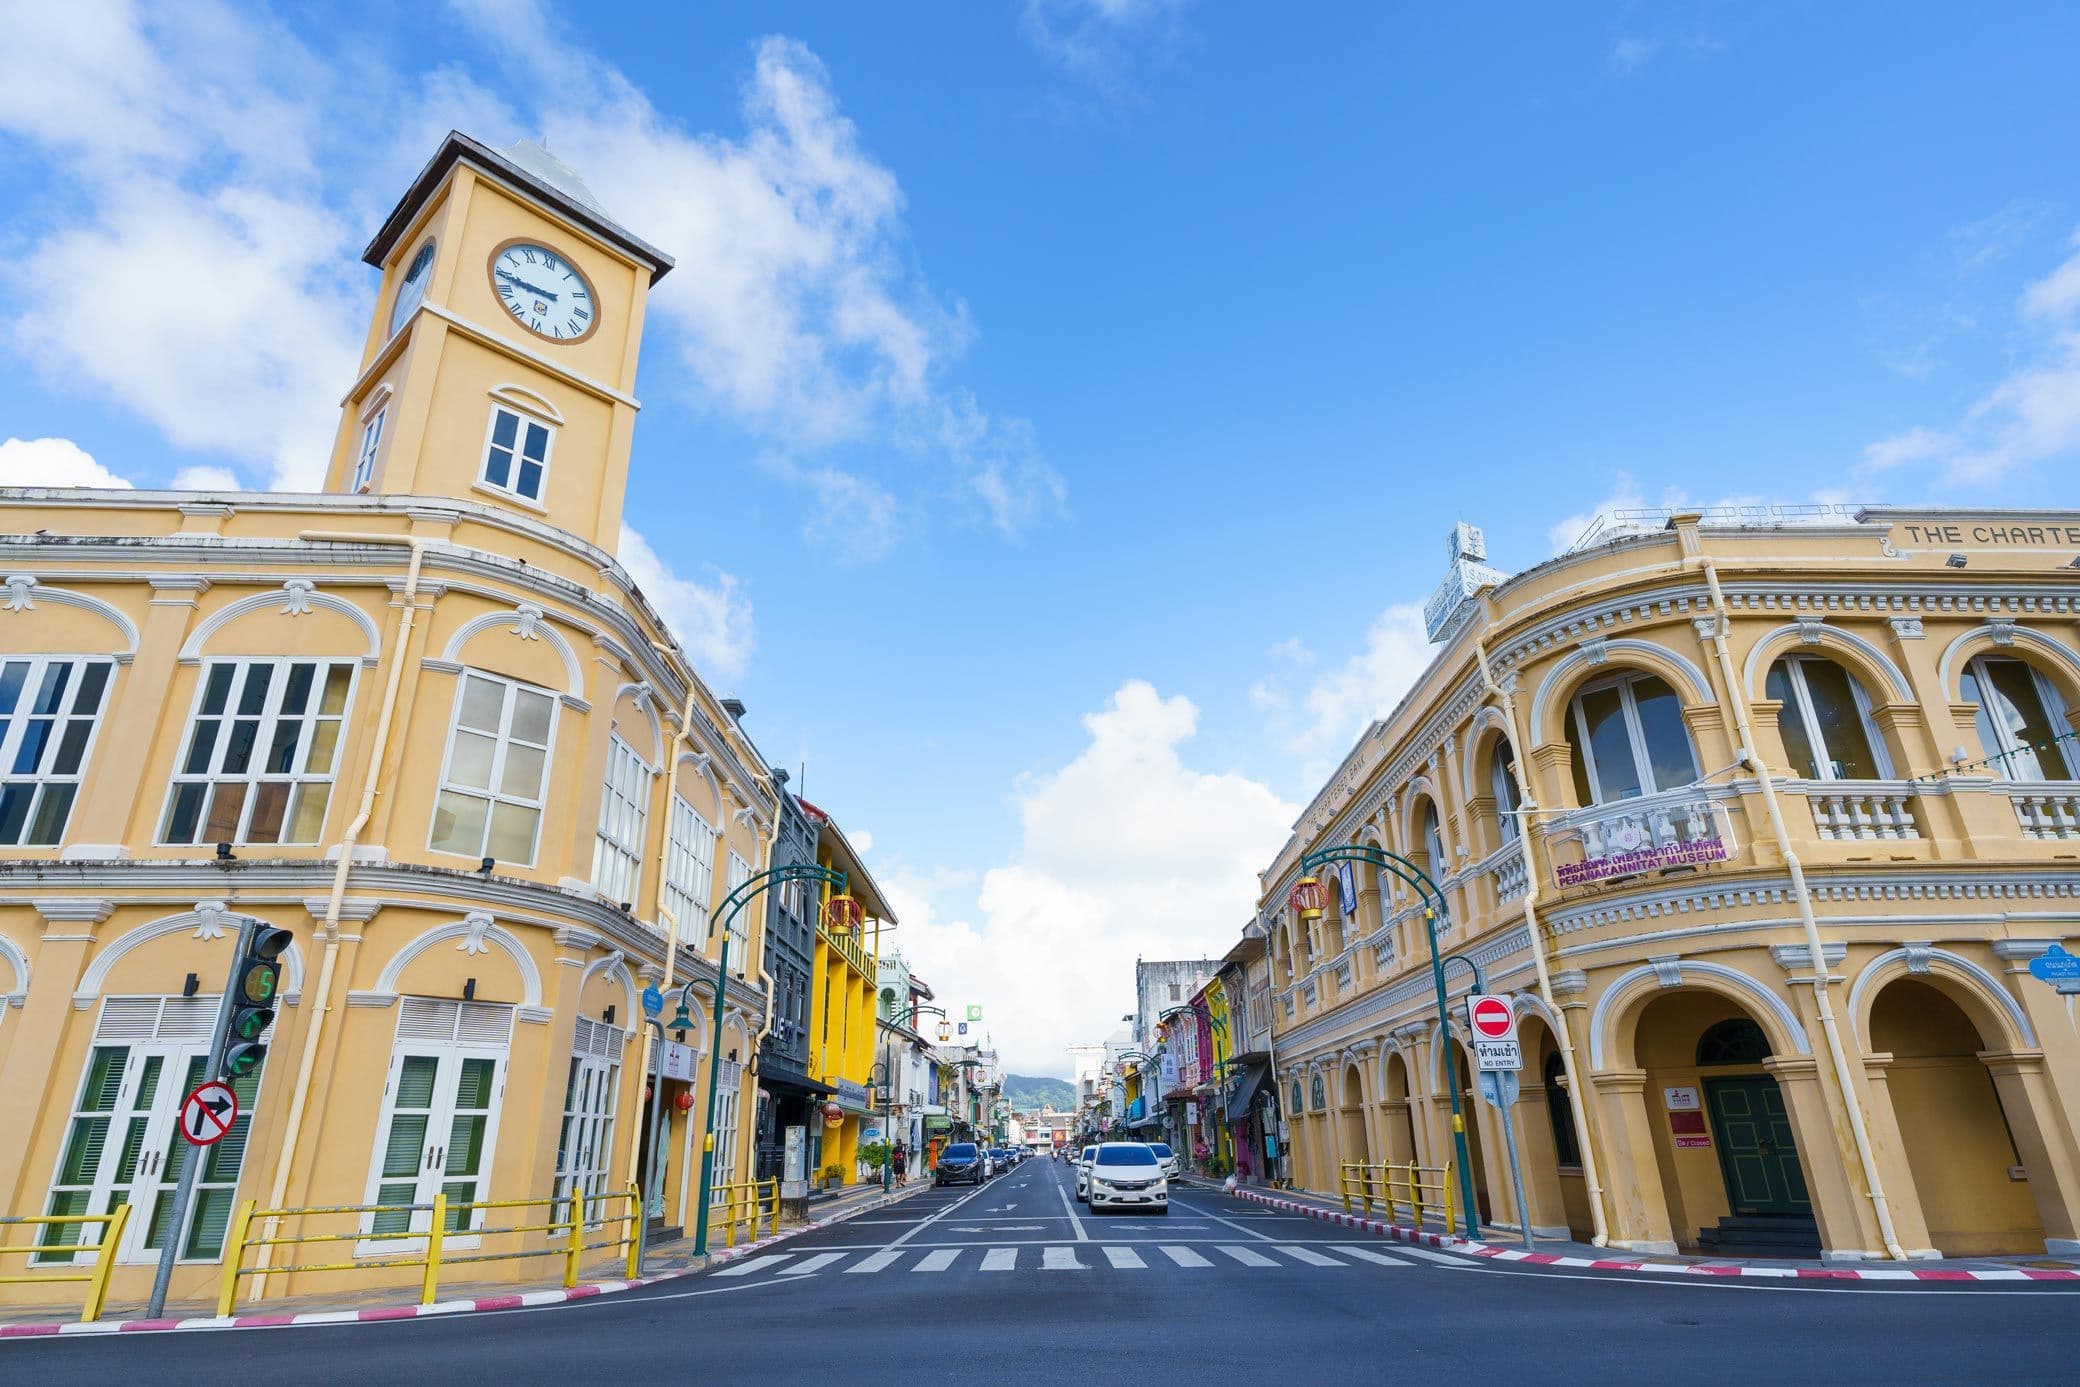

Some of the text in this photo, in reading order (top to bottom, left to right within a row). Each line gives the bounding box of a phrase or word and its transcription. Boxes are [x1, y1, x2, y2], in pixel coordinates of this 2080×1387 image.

[504, 252, 520, 268] X
[522, 250, 536, 263] XI
[542, 254, 557, 271] XII
[510, 303, 525, 319] VII
[573, 306, 589, 320] III
[531, 317, 541, 333] VI
[554, 325, 564, 339] V
[567, 319, 582, 335] IV
[1904, 526, 2080, 545] THE CHARTE
[1559, 849, 1727, 887] PERANAKANNITAT MUSEUM
[260, 970, 274, 998] 5
[1479, 1042, 1518, 1057] ห้ามเข้า
